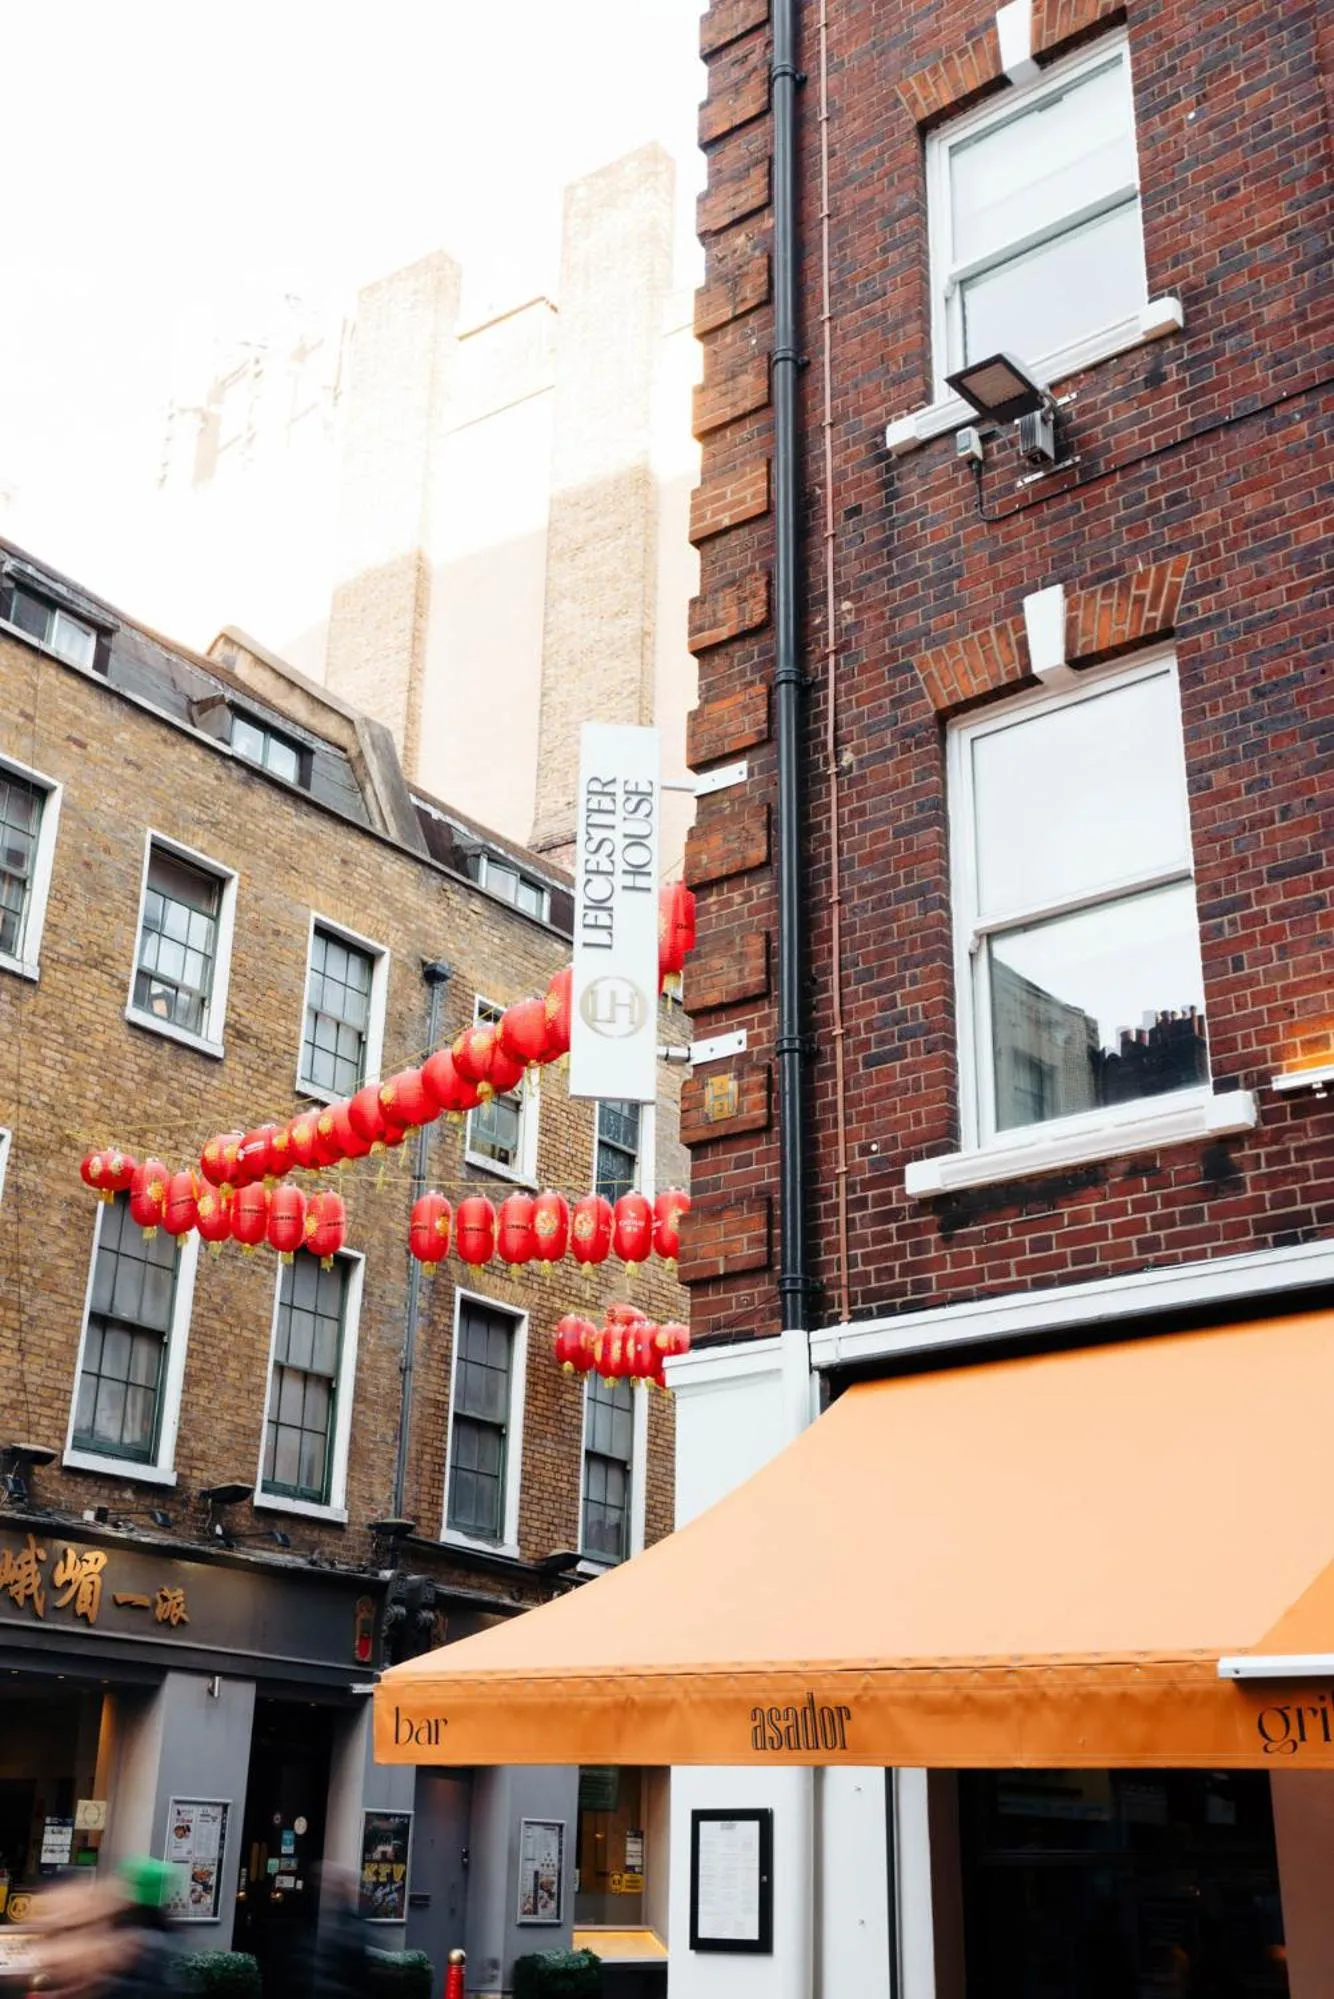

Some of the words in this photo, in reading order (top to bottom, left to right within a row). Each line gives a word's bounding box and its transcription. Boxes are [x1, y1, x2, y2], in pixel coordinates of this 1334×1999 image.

[582, 776, 617, 950] LEICESTER
[621, 779, 654, 893] HOUSE
[395, 1706, 448, 1745] bar
[751, 1691, 851, 1750] asador
[1257, 1691, 1334, 1755] gri
